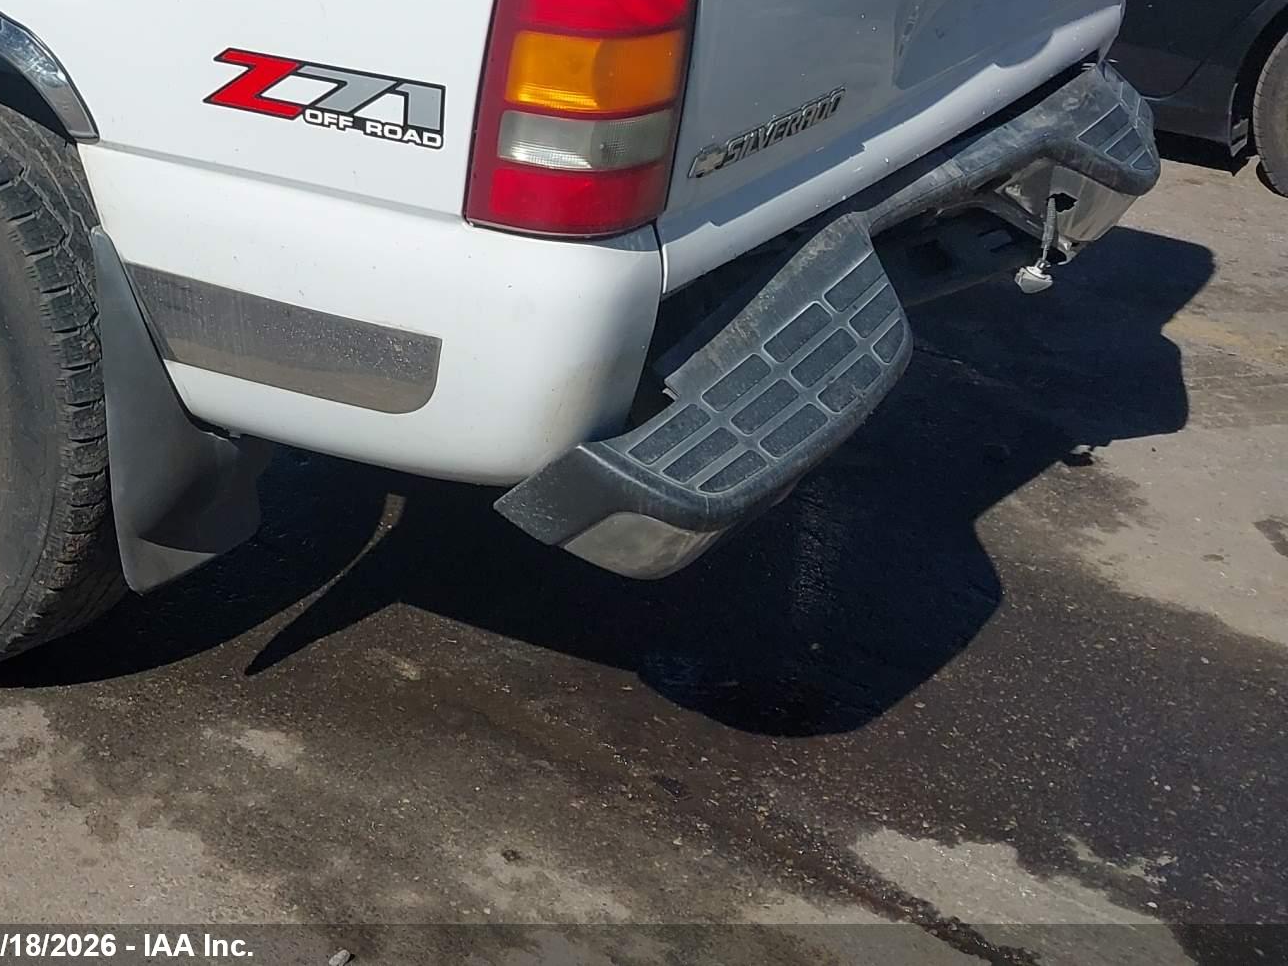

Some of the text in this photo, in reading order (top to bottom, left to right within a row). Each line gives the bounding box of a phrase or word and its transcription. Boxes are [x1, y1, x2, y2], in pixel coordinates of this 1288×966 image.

[203, 47, 446, 133] Z71
[304, 108, 444, 149] OFF ROAD
[724, 87, 844, 165] SILVERADO
